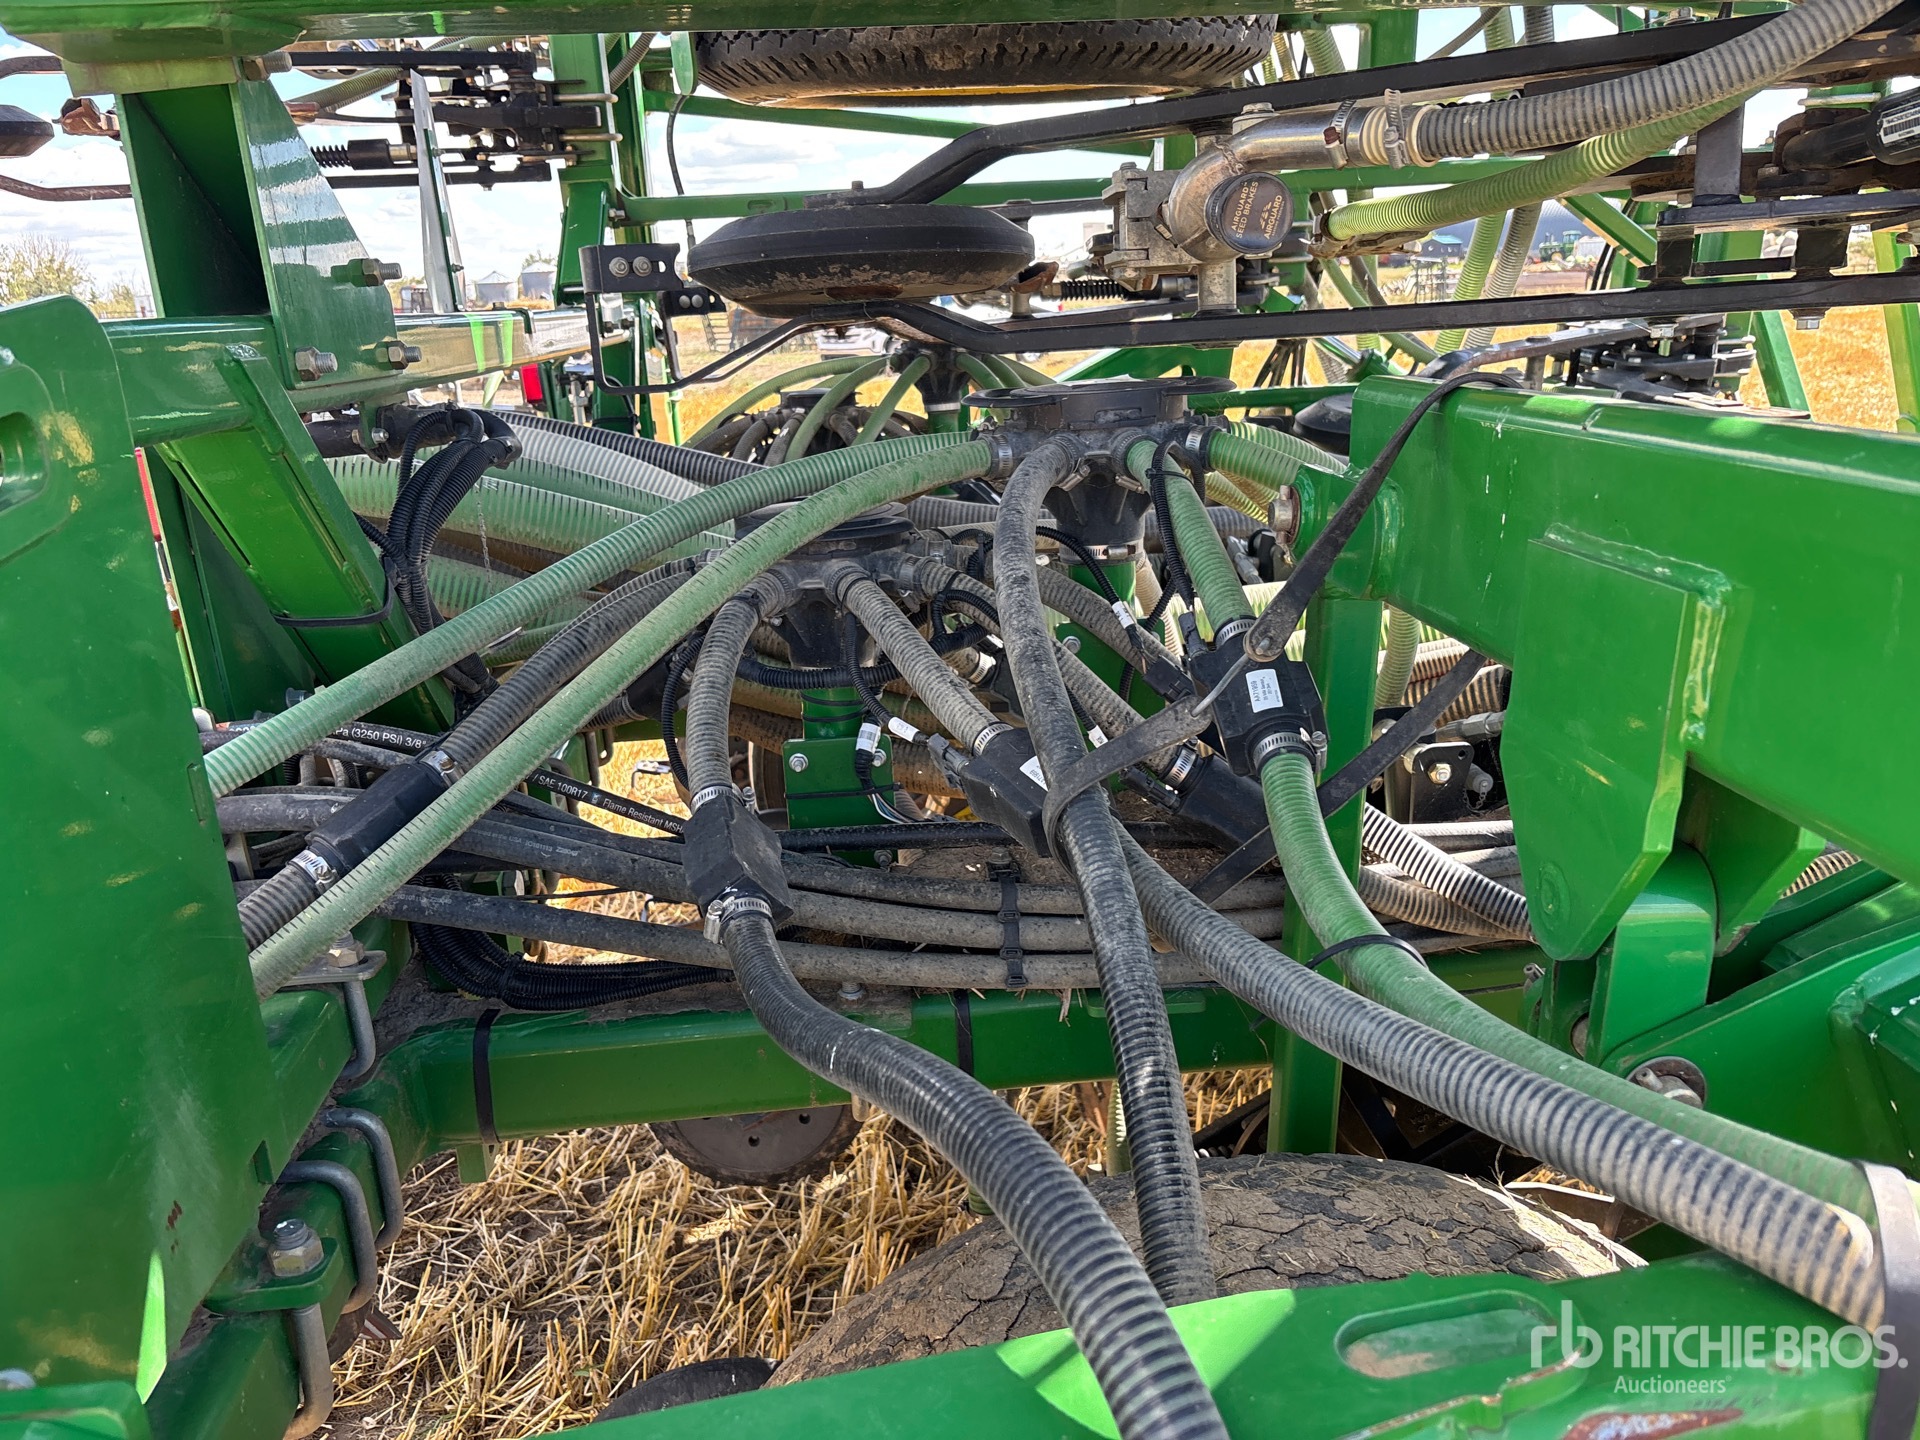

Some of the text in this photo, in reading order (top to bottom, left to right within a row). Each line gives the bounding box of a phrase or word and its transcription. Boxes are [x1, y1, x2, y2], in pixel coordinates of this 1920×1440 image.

[1236, 181, 1259, 239] SEED BRAKES
[1263, 195, 1283, 240] AIRGUARD
[351, 727, 380, 741] (3250
[382, 732, 403, 746] PSI)
[539, 774, 556, 790] SAE
[557, 781, 589, 799] 100R17
[602, 797, 627, 814] Flame
[628, 806, 664, 828] Resistant
[664, 819, 685, 834] MSH
